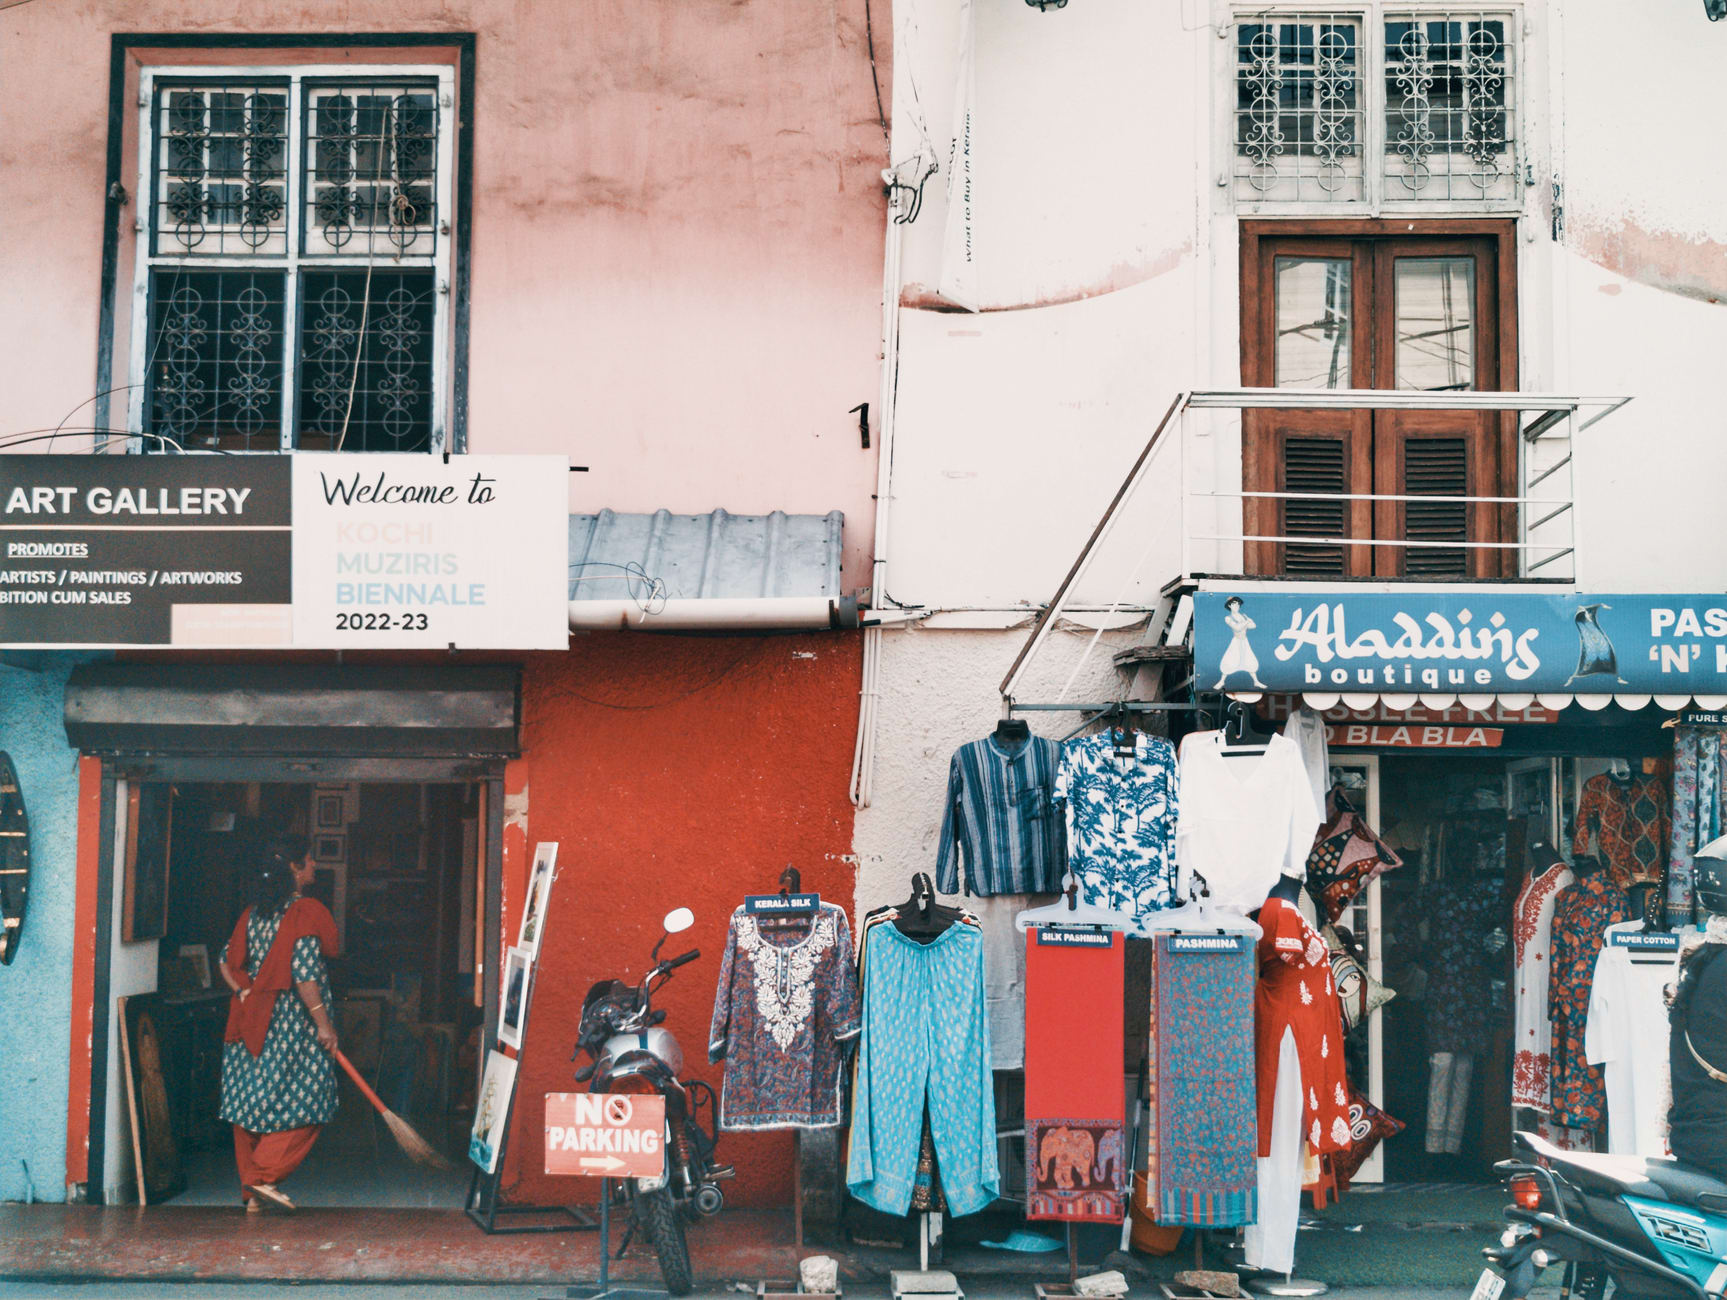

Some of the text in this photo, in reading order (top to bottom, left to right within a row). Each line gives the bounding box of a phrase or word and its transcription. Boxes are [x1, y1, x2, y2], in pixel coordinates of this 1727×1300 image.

[964, 176, 972, 203] Buy
[320, 471, 497, 506] Welcome to
[5, 487, 252, 515] ART GALLERY
[336, 522, 433, 545] KOCHI
[8, 543, 89, 557] PROMOTES
[336, 552, 459, 575] MUZIRIS
[0, 570, 57, 584] ARTISTS
[70, 570, 147, 585] PAINTINGS
[160, 571, 243, 585] ARTWORKS
[0, 591, 132, 605] BITION CUM SALES
[336, 583, 486, 605] BIENNALE
[336, 613, 429, 631] 2022-23
[1650, 607, 1727, 637] PAS
[1304, 663, 1492, 689] boutique
[1688, 714, 1719, 723] PURE
[1346, 725, 1414, 745] BLA
[1421, 726, 1488, 746] BLA
[754, 898, 812, 909] KERALA SILK
[1041, 932, 1109, 944] SILK PASHMINA
[1175, 937, 1239, 949] PASHMINA
[1616, 935, 1676, 945] PAPER COTTON
[575, 1094, 633, 1127] NO
[549, 1126, 659, 1155] PARKING
